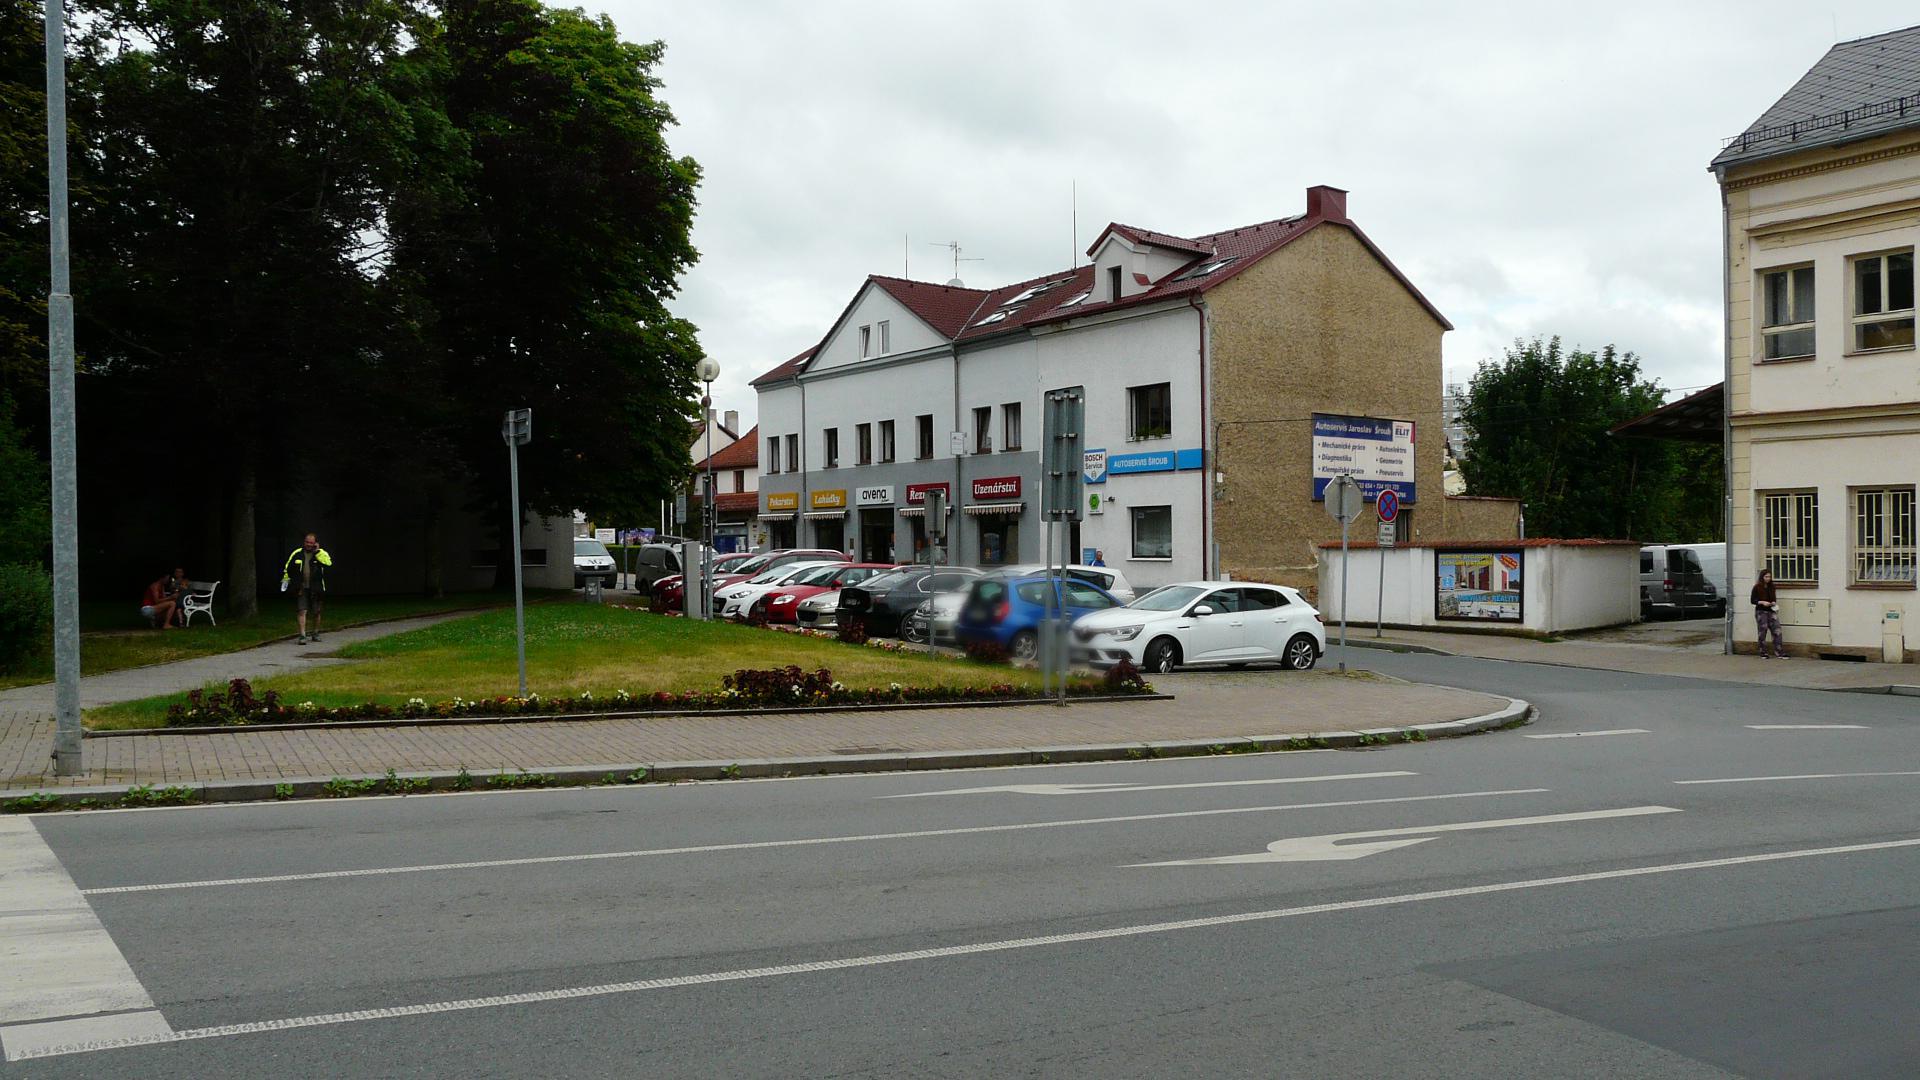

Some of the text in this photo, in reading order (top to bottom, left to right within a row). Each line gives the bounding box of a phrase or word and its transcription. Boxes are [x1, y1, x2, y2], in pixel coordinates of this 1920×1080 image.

[1315, 421, 1348, 432] Autoservis
[1348, 424, 1372, 434] Jaroslav
[1395, 428, 1410, 437] ELIT
[1321, 441, 1351, 450] Mechanické
[1084, 453, 1103, 462] BOSCH
[1321, 454, 1352, 462] Diagnostika
[1379, 457, 1403, 465] Geometrie
[1085, 462, 1103, 470] Service
[1113, 458, 1147, 468] AUTOSERVIS
[1379, 469, 1404, 477] Pneuservis
[974, 481, 1016, 495] Uzenářství
[862, 488, 887, 500] avena
